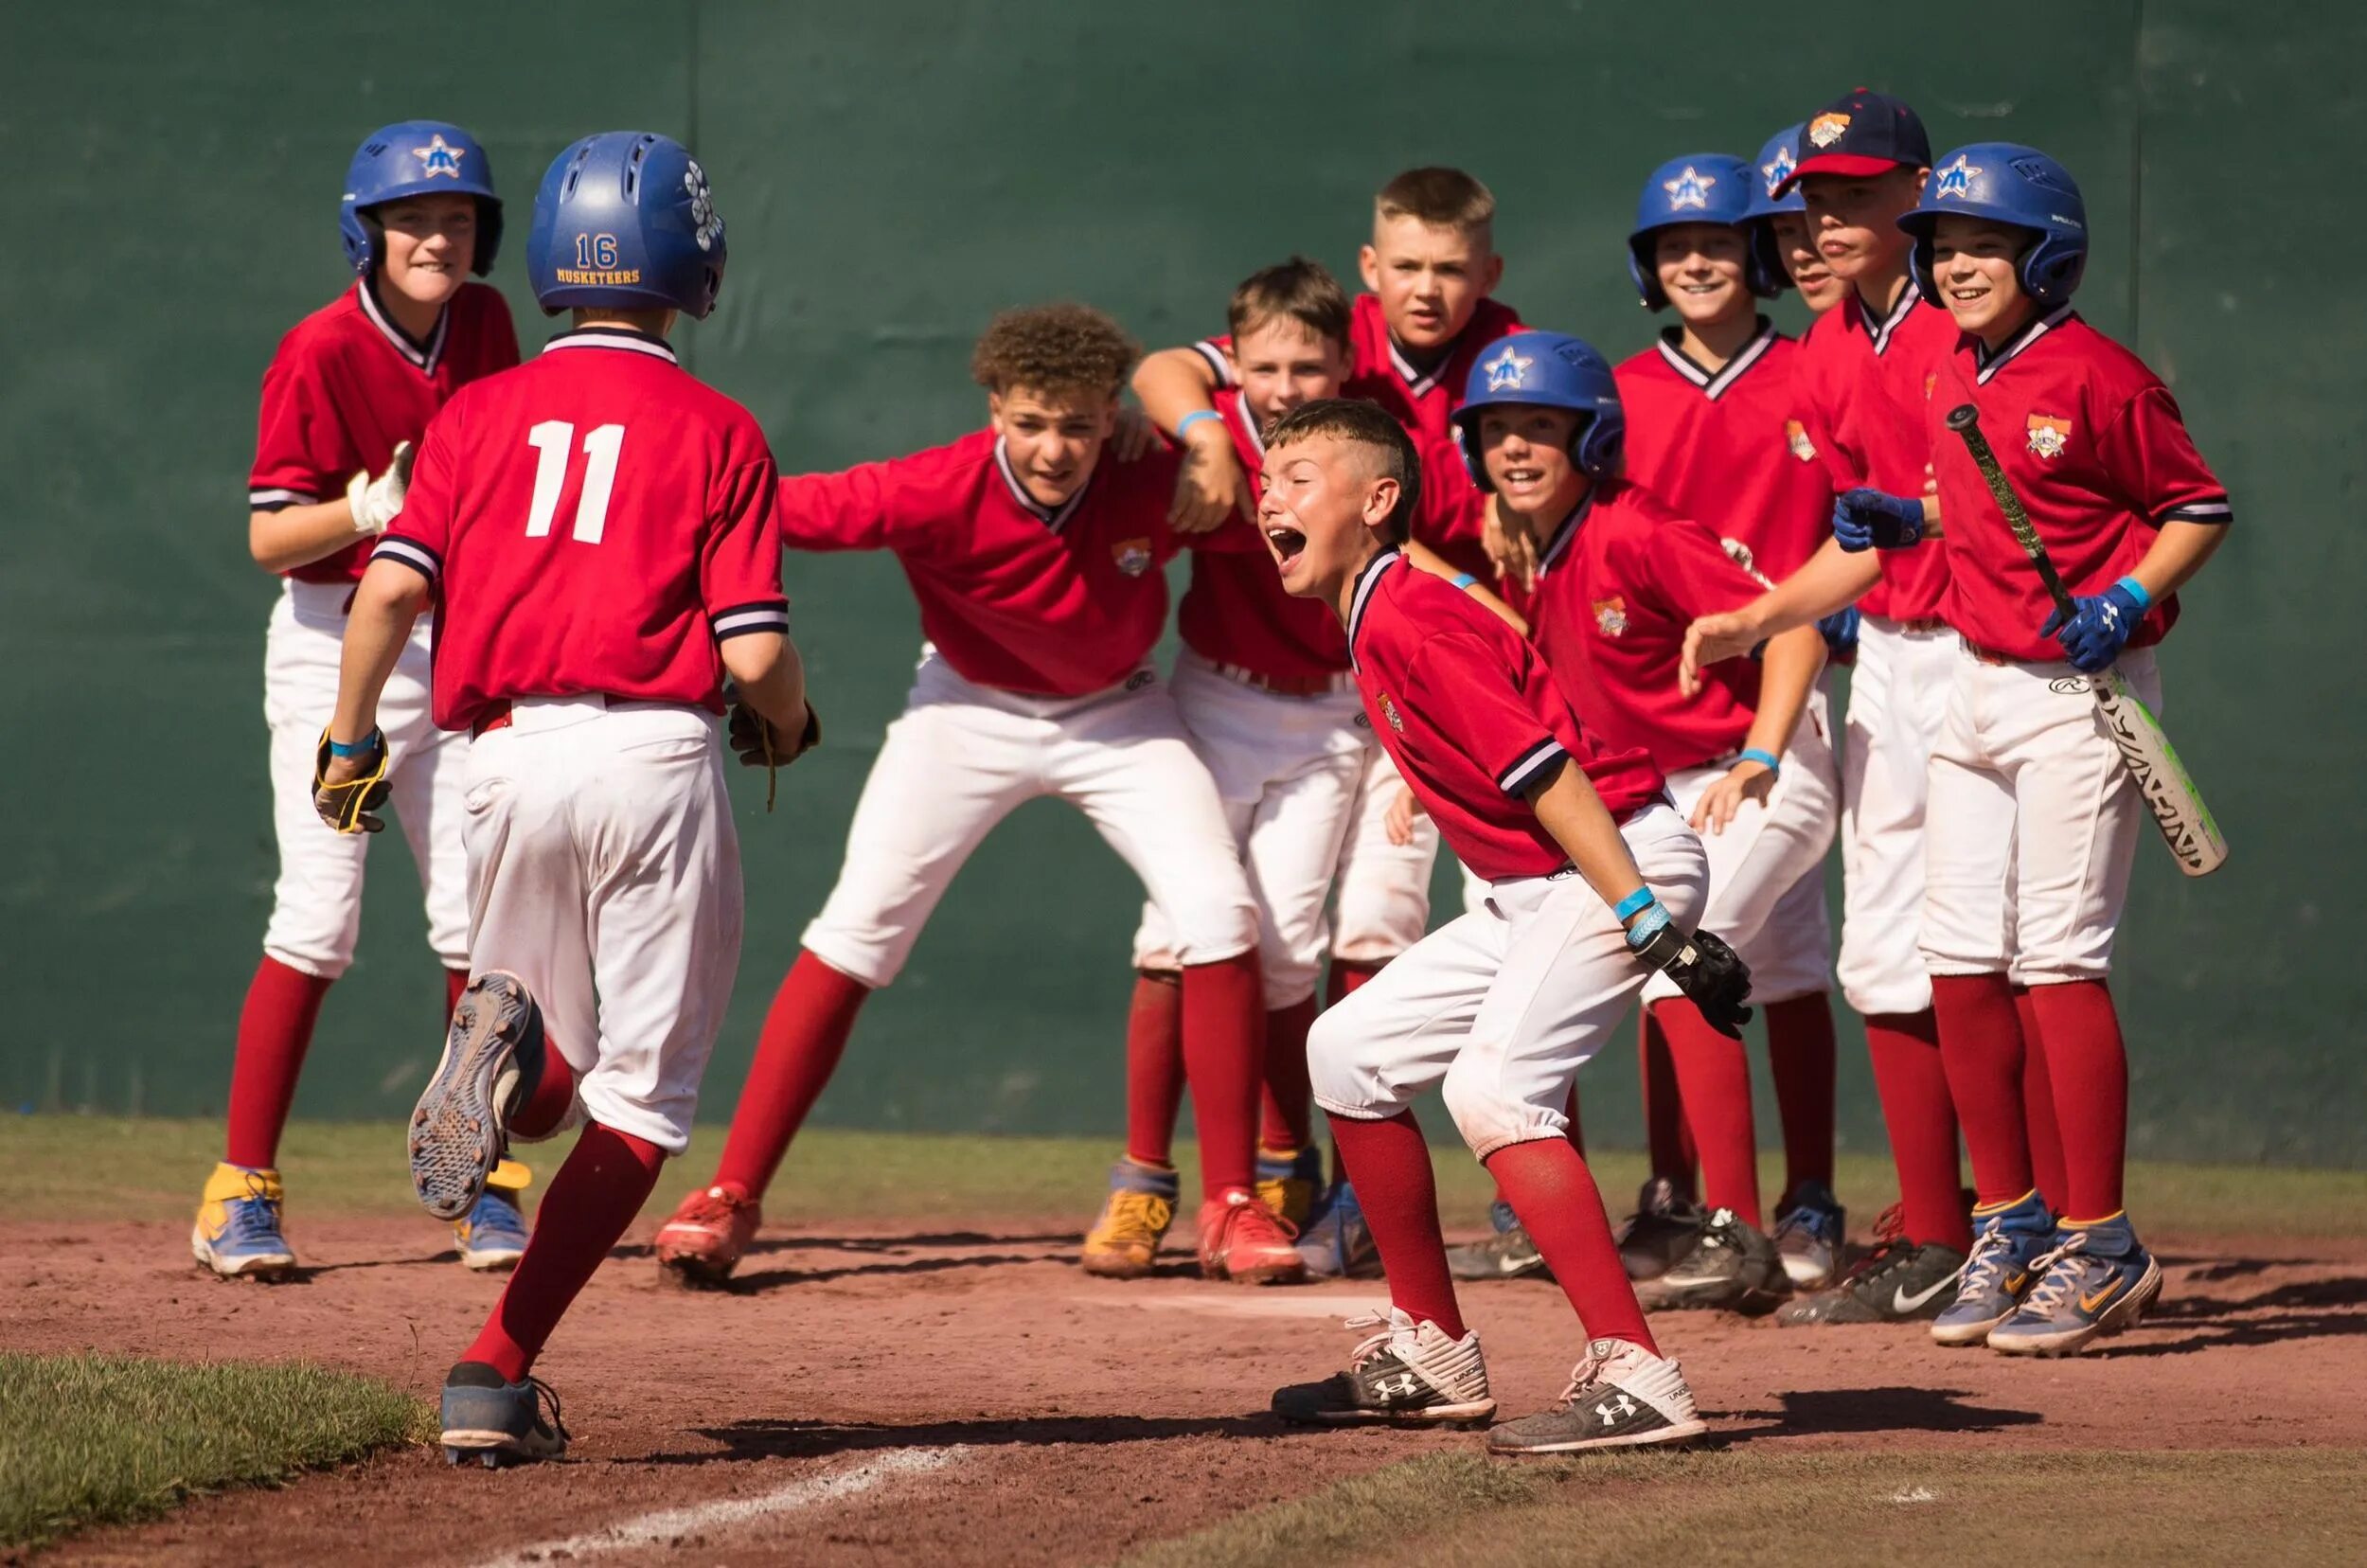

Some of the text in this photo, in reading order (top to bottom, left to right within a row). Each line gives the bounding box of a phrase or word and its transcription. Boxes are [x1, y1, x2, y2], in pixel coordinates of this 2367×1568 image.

[576, 233, 617, 269] 16
[557, 268, 640, 285] MUSKETEERS
[525, 419, 626, 545] 11
